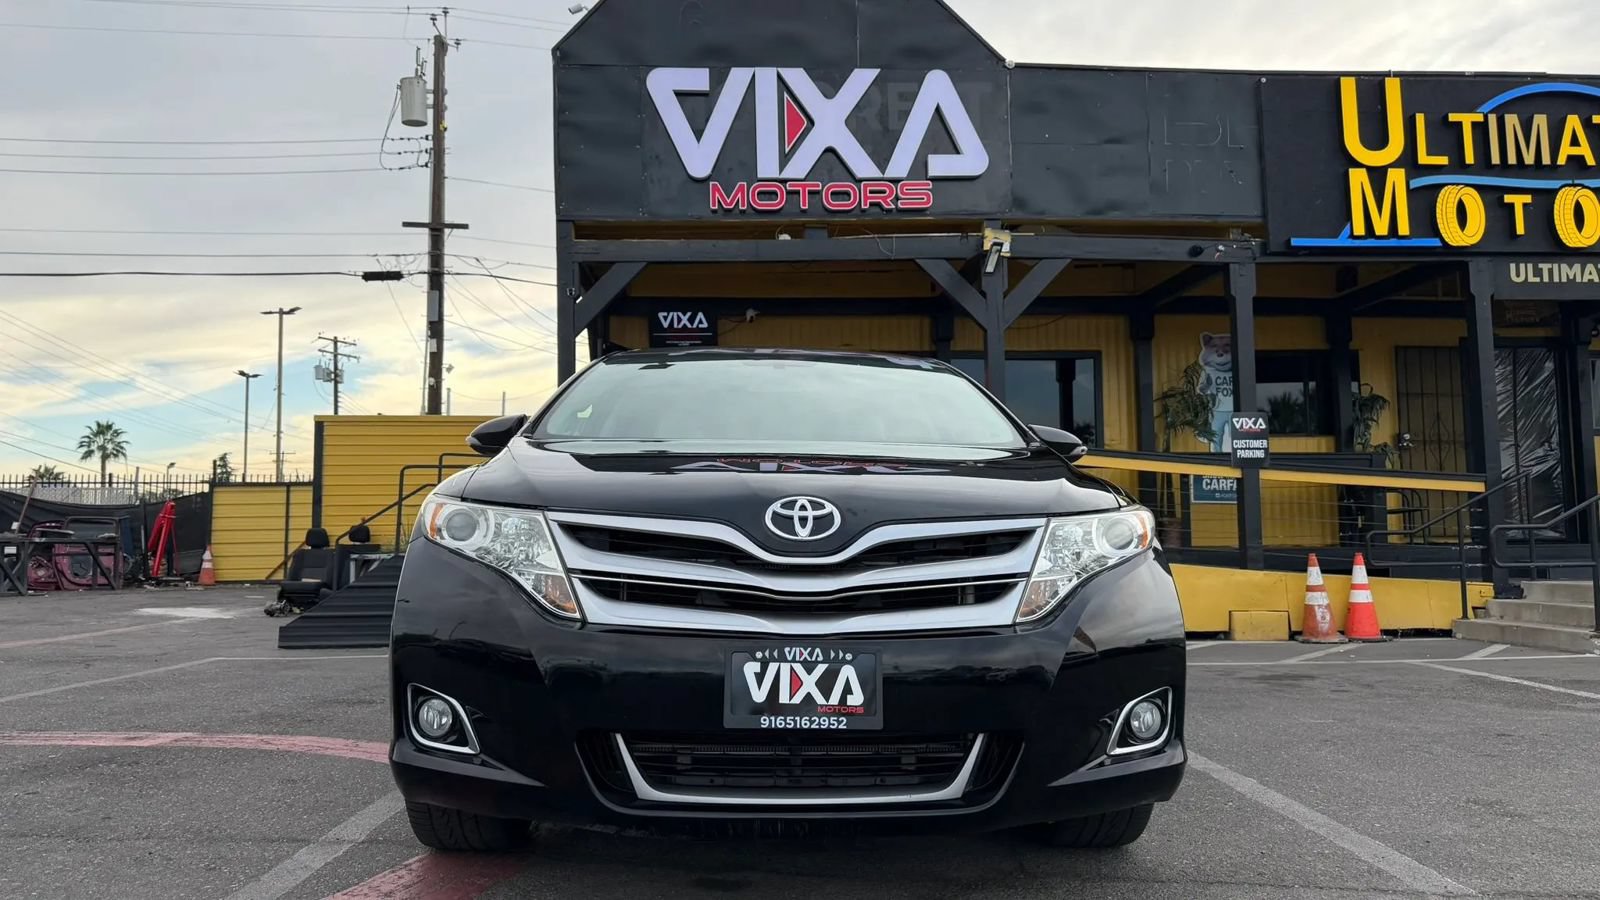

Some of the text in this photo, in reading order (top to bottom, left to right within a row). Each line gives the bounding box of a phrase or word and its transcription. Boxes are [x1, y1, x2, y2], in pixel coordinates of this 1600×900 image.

[646, 67, 989, 179] VIXA
[709, 181, 933, 210] MOTORS
[1509, 263, 1600, 283] ULTIMA
[658, 312, 708, 328] VIXA
[1232, 418, 1266, 429] VIXA
[1233, 440, 1268, 448] CUSTOMER
[1237, 449, 1265, 458] PARKING
[784, 647, 823, 661] VIXA
[743, 662, 864, 706] VIXA
[760, 716, 847, 729] 9165162952
